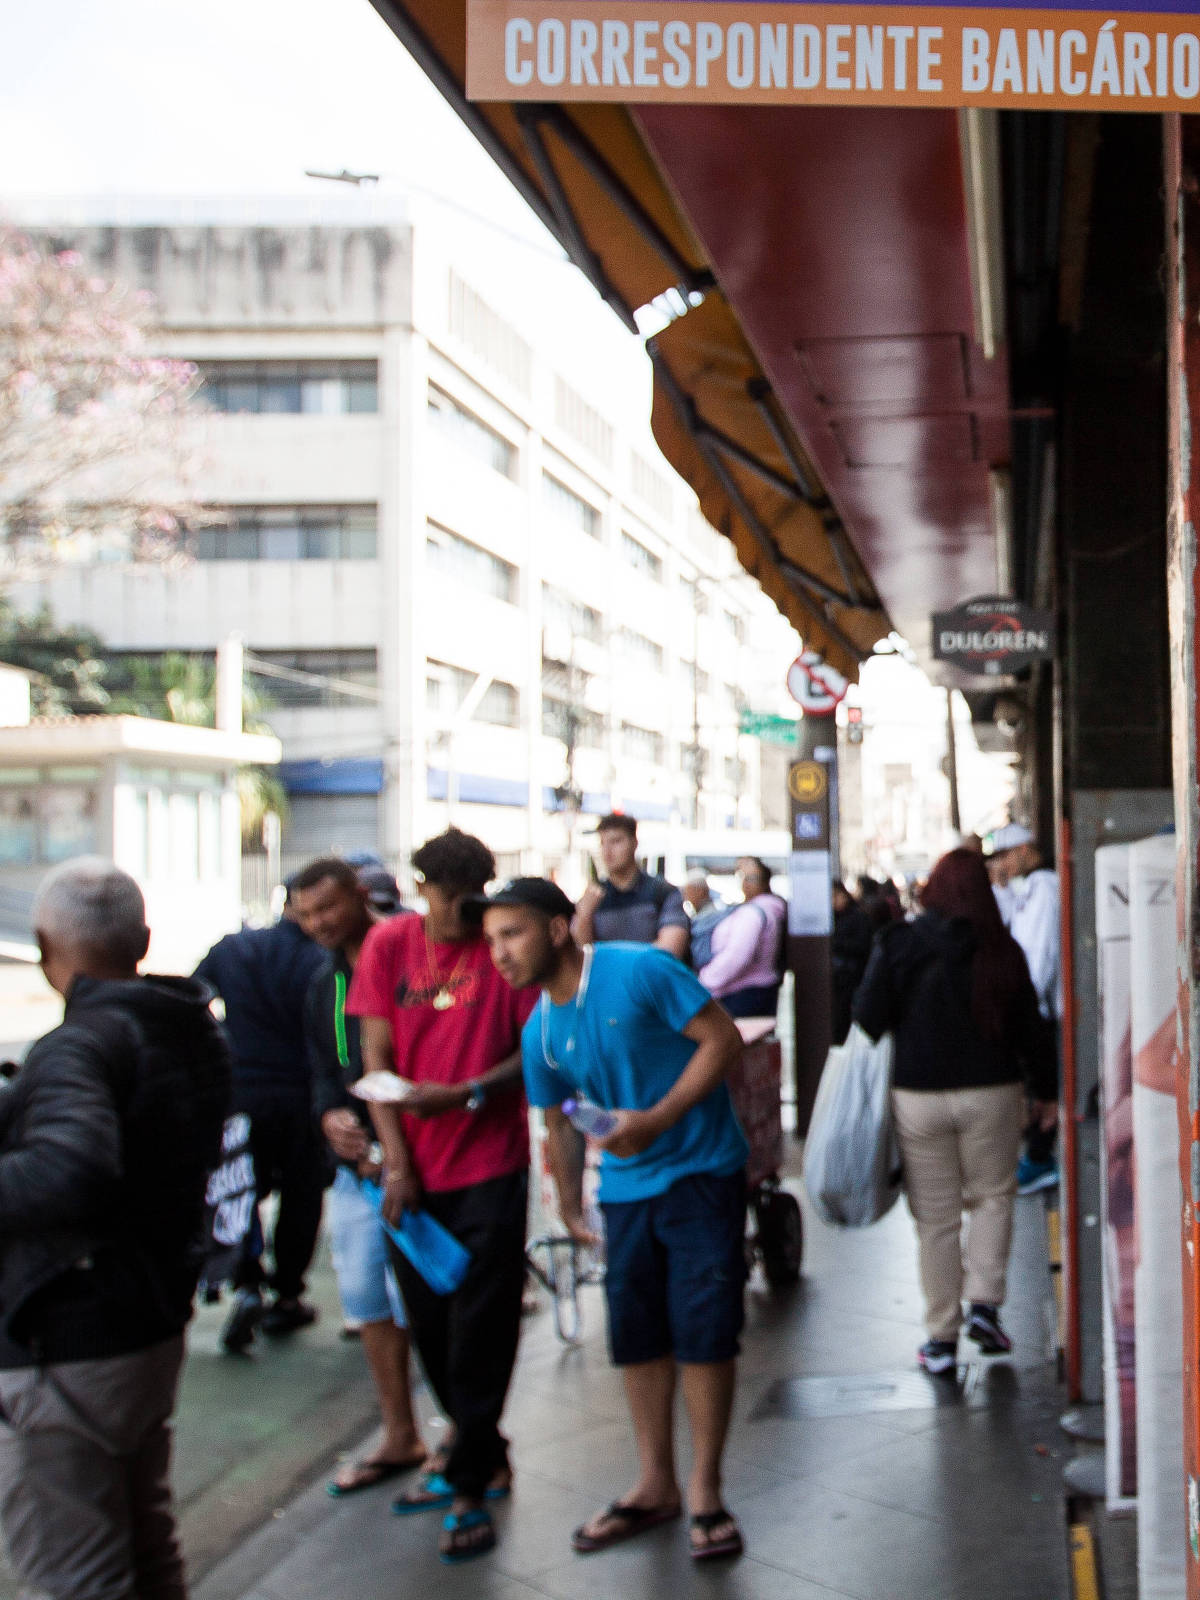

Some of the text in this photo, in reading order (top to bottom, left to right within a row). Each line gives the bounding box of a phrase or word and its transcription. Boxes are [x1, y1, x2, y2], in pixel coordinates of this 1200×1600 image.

[504, 18, 1200, 99] CORRESPONDENTE BANCÁRIO
[939, 630, 1049, 654] DULOREN
